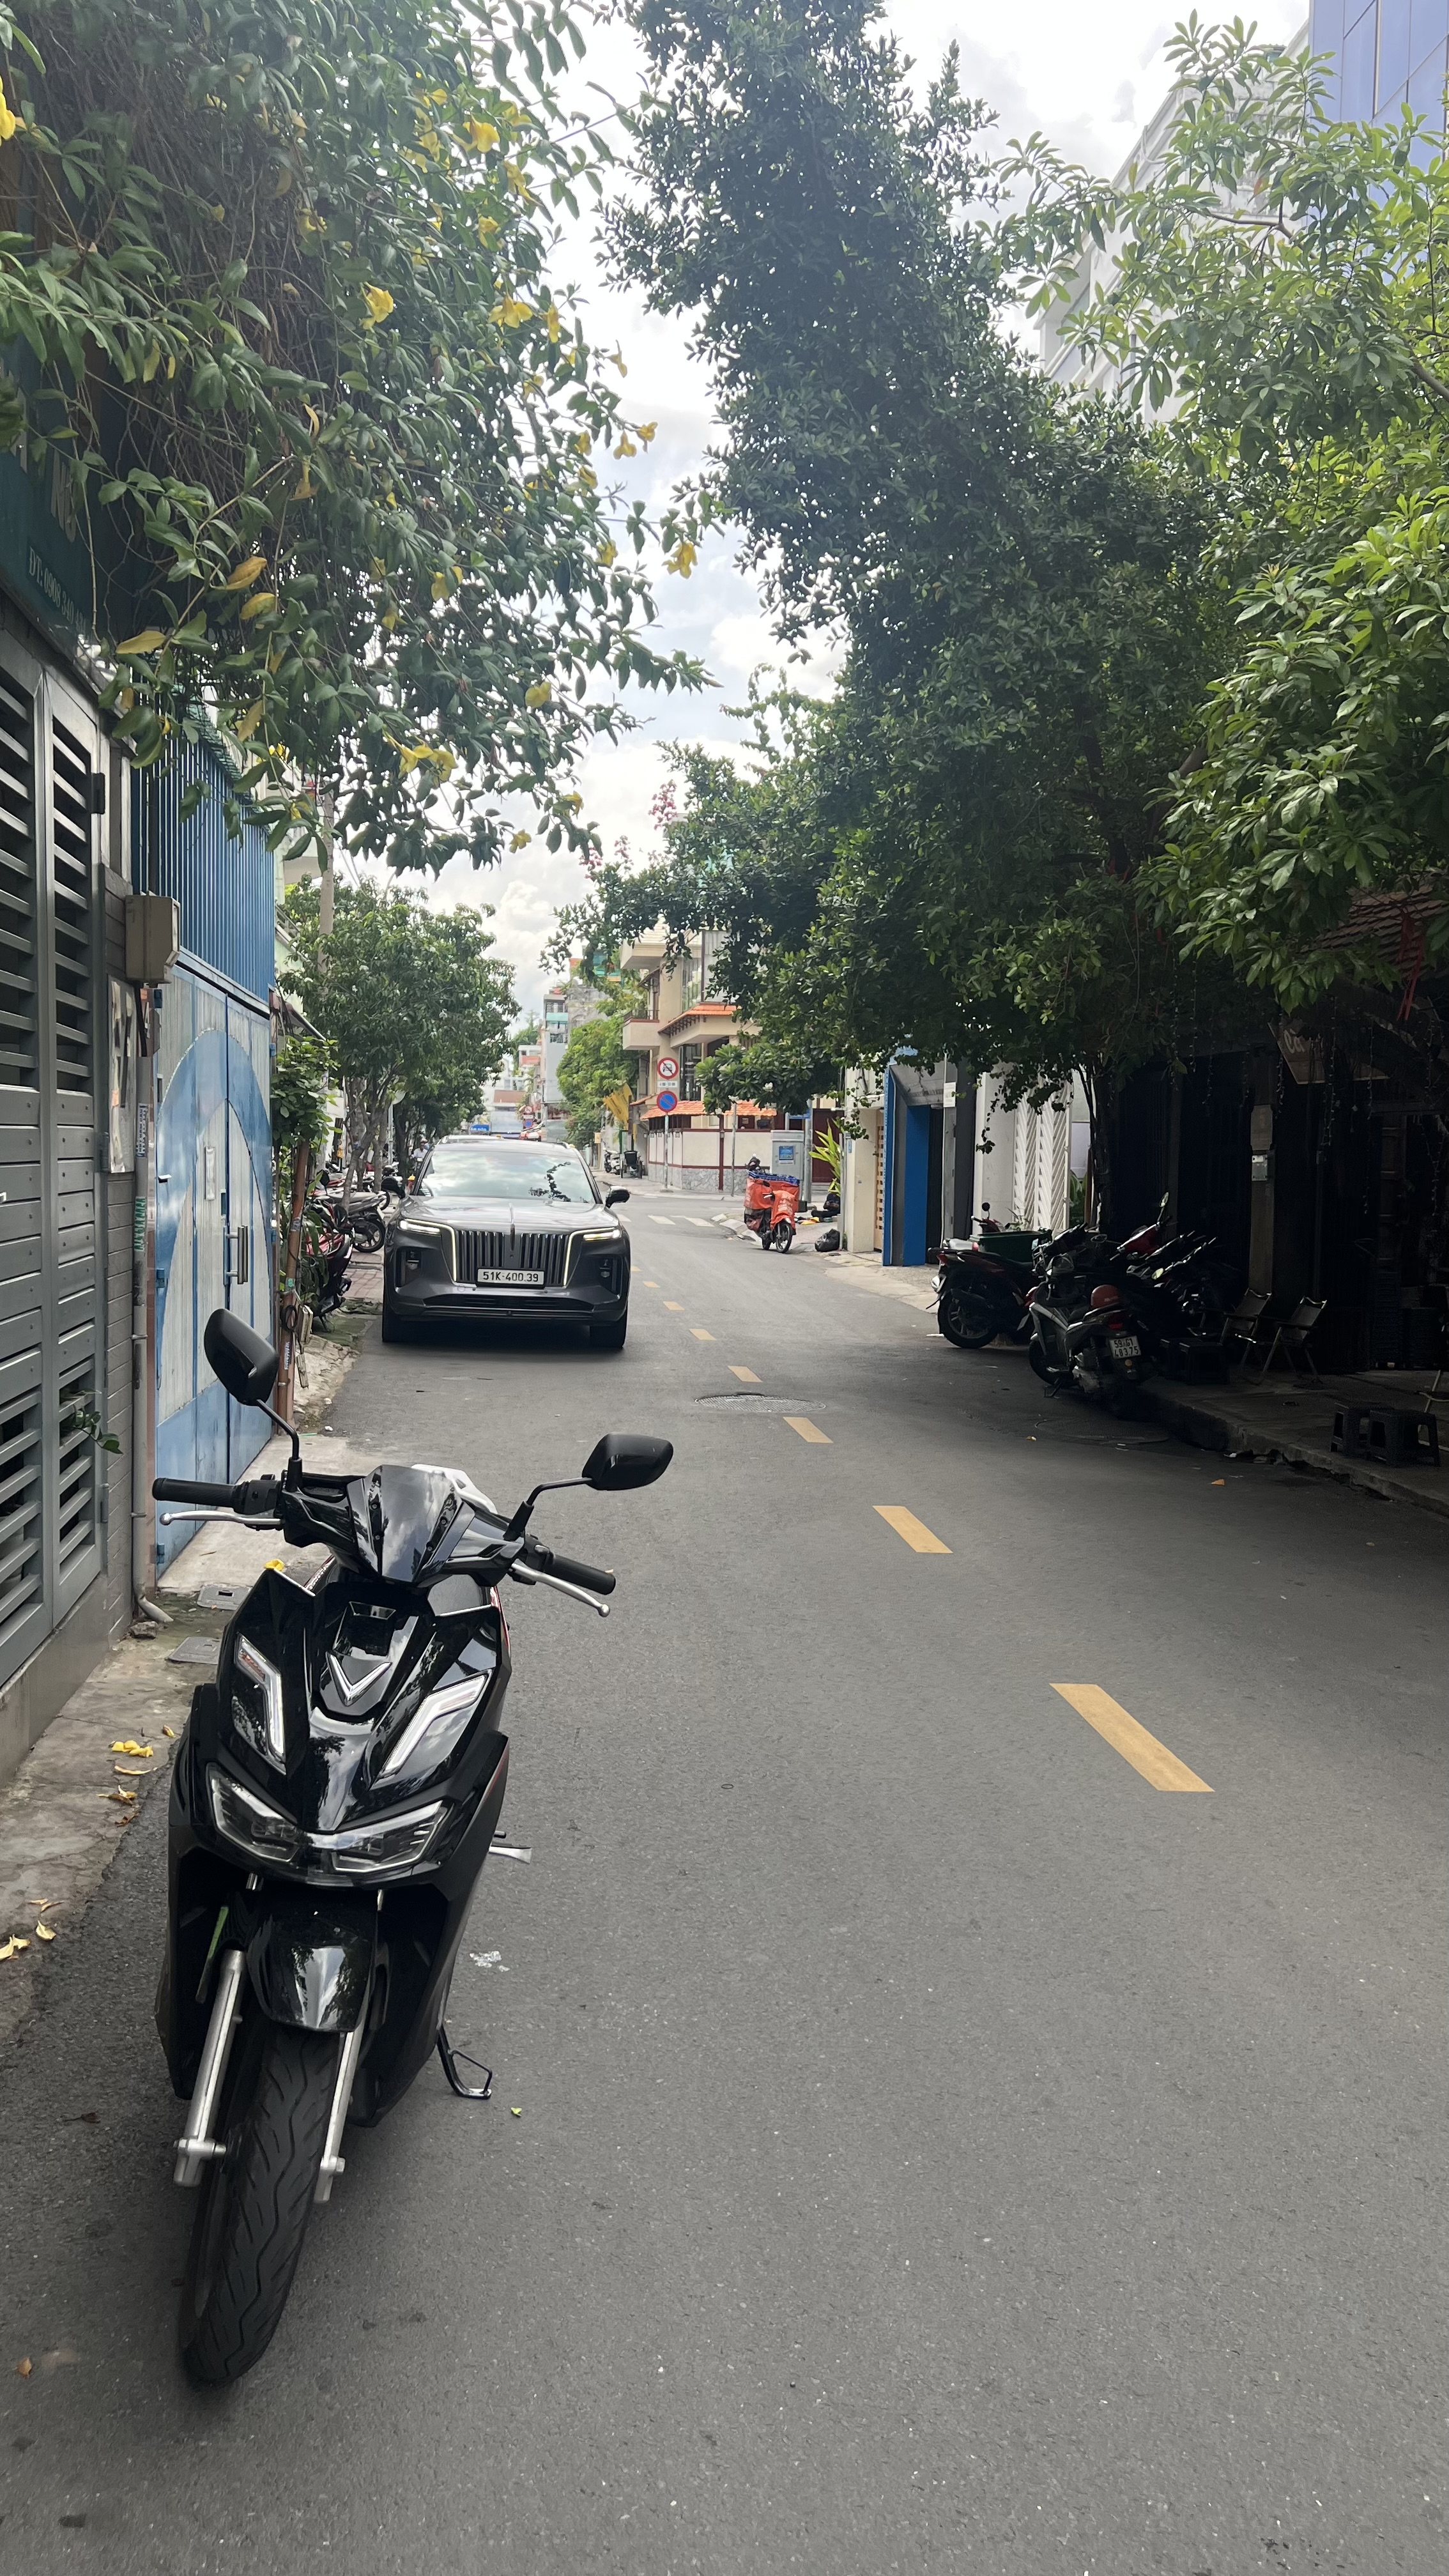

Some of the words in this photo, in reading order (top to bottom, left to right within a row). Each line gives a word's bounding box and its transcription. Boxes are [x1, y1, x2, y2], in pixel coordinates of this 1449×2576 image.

[29, 546, 43, 586] ĐT:
[44, 567, 61, 608] 0908
[482, 1271, 539, 1283] 51K-400.39
[1114, 1346, 1139, 1358] 483.75
